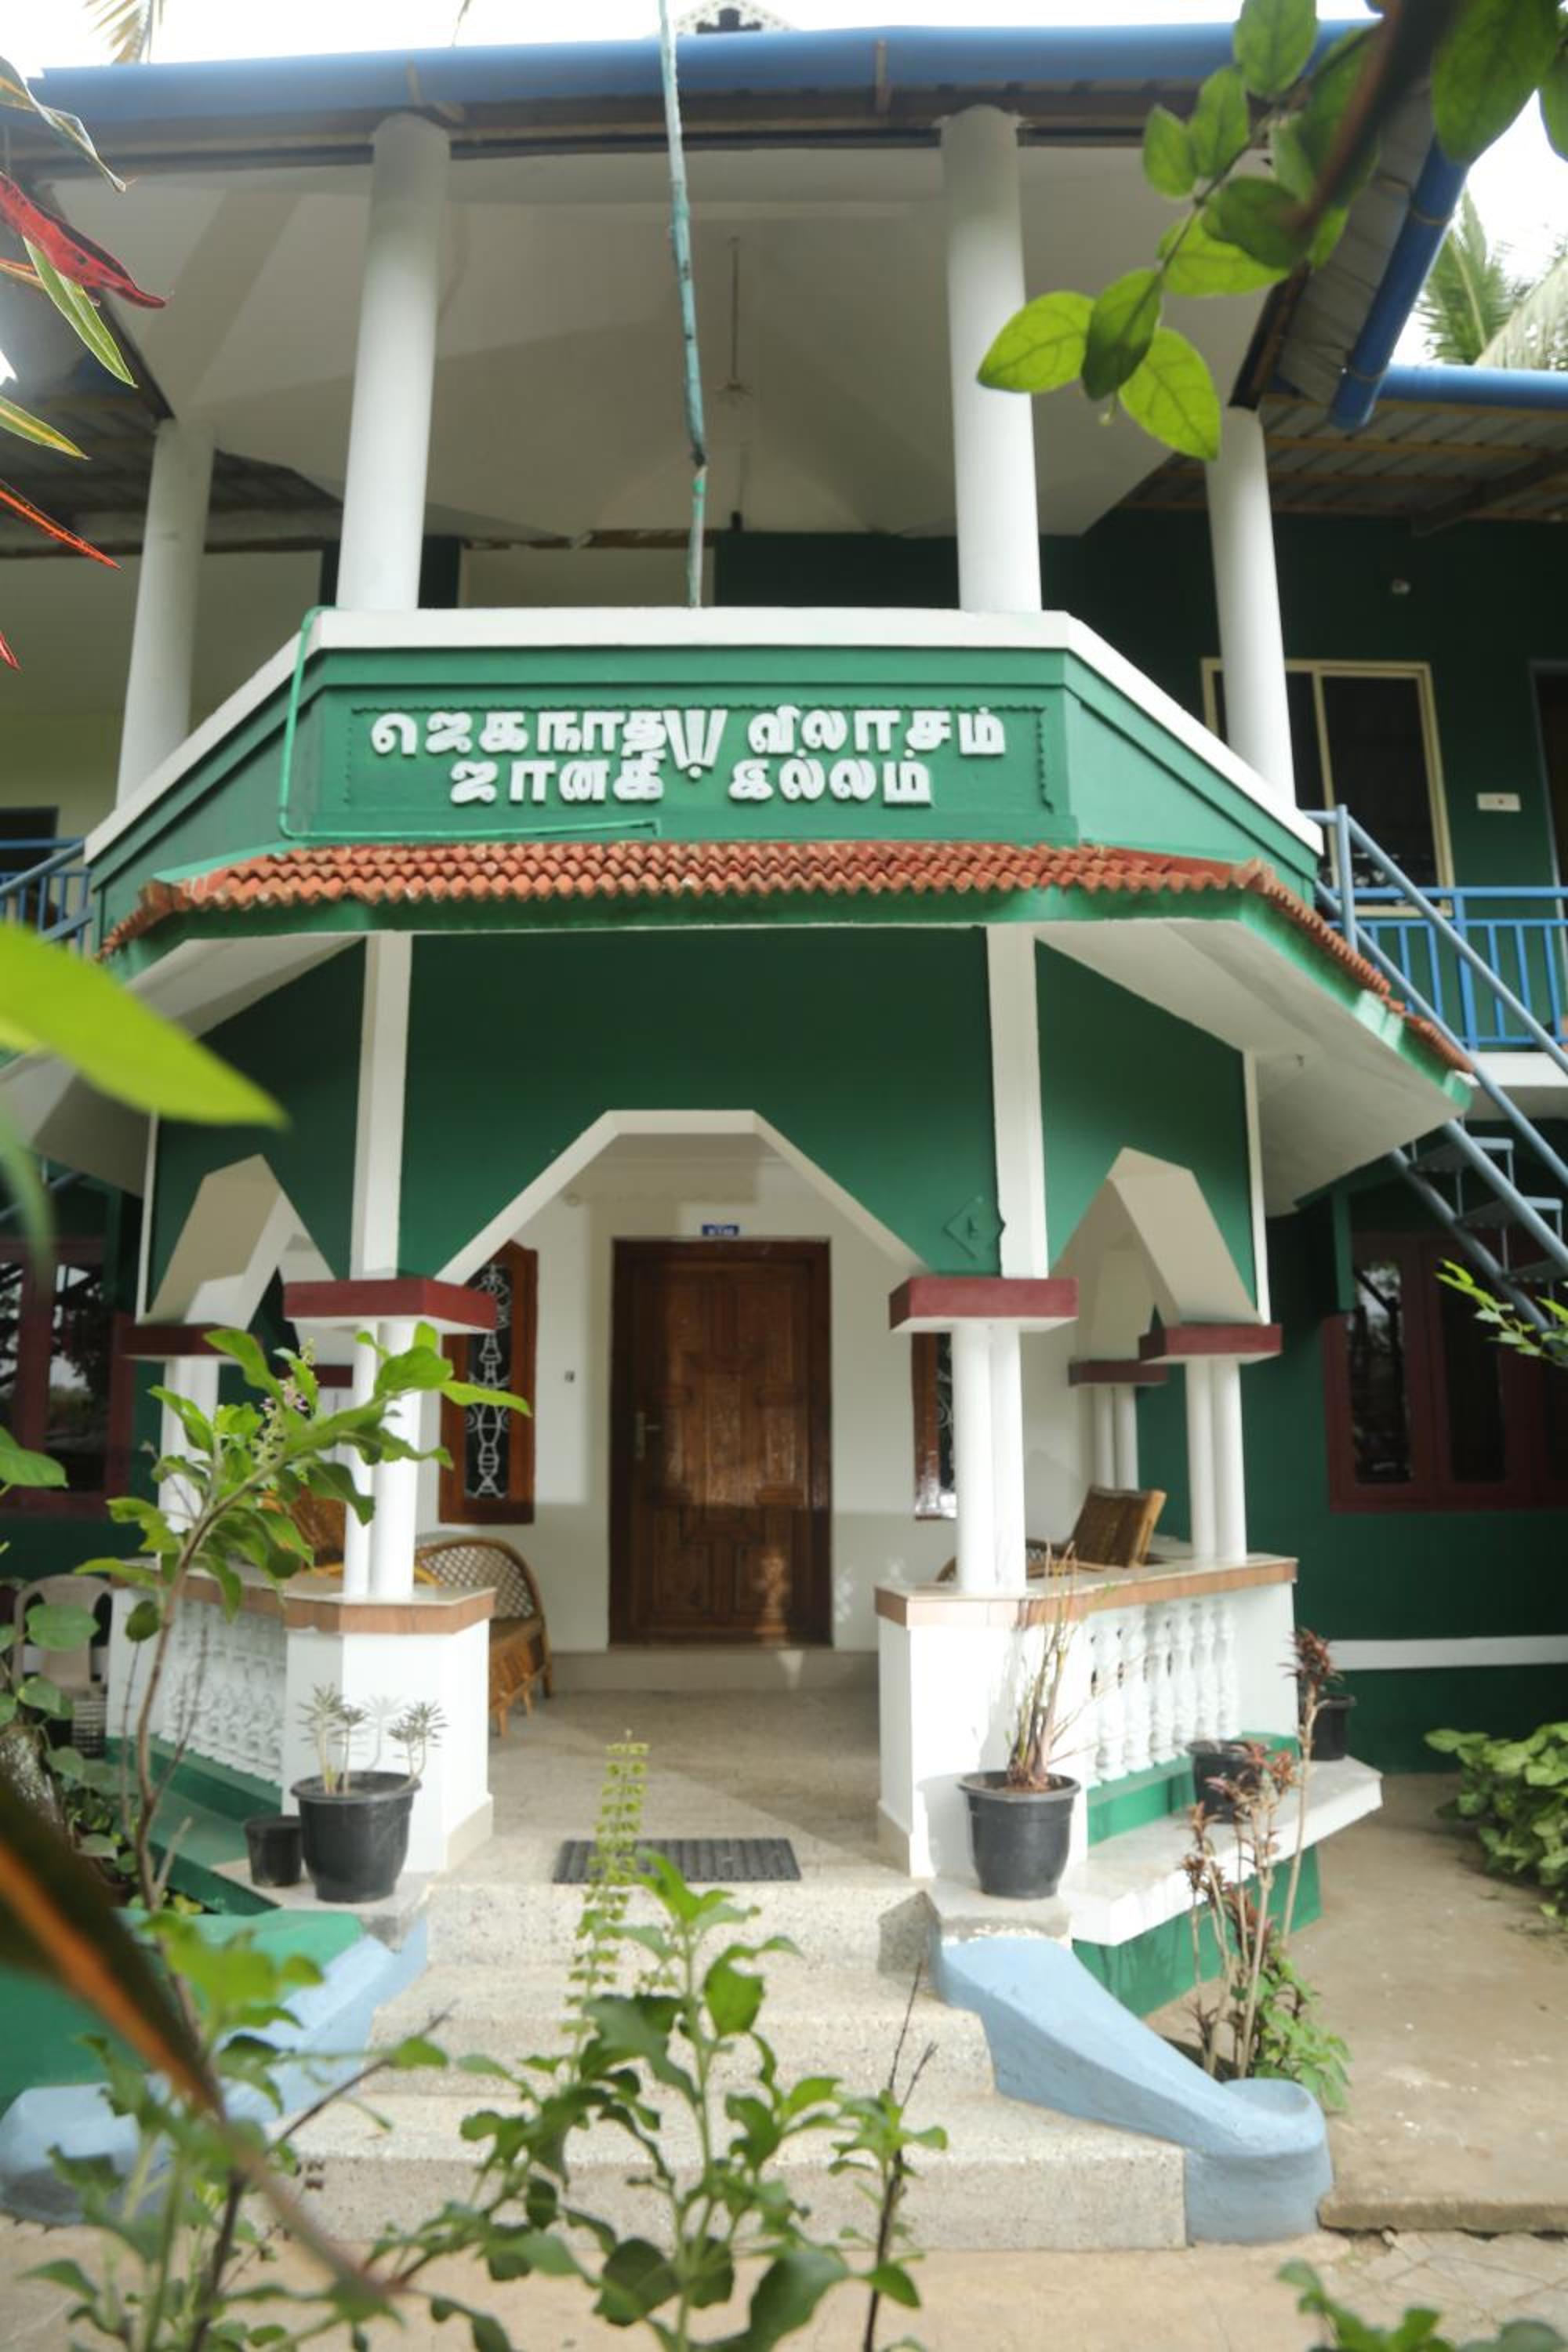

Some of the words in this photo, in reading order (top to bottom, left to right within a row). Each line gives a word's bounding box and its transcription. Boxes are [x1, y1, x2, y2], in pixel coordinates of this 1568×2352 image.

[371, 710, 666, 757] ஜெகநாத
[748, 705, 1006, 755] விலாசம்
[728, 748, 931, 804] இல்லம்
